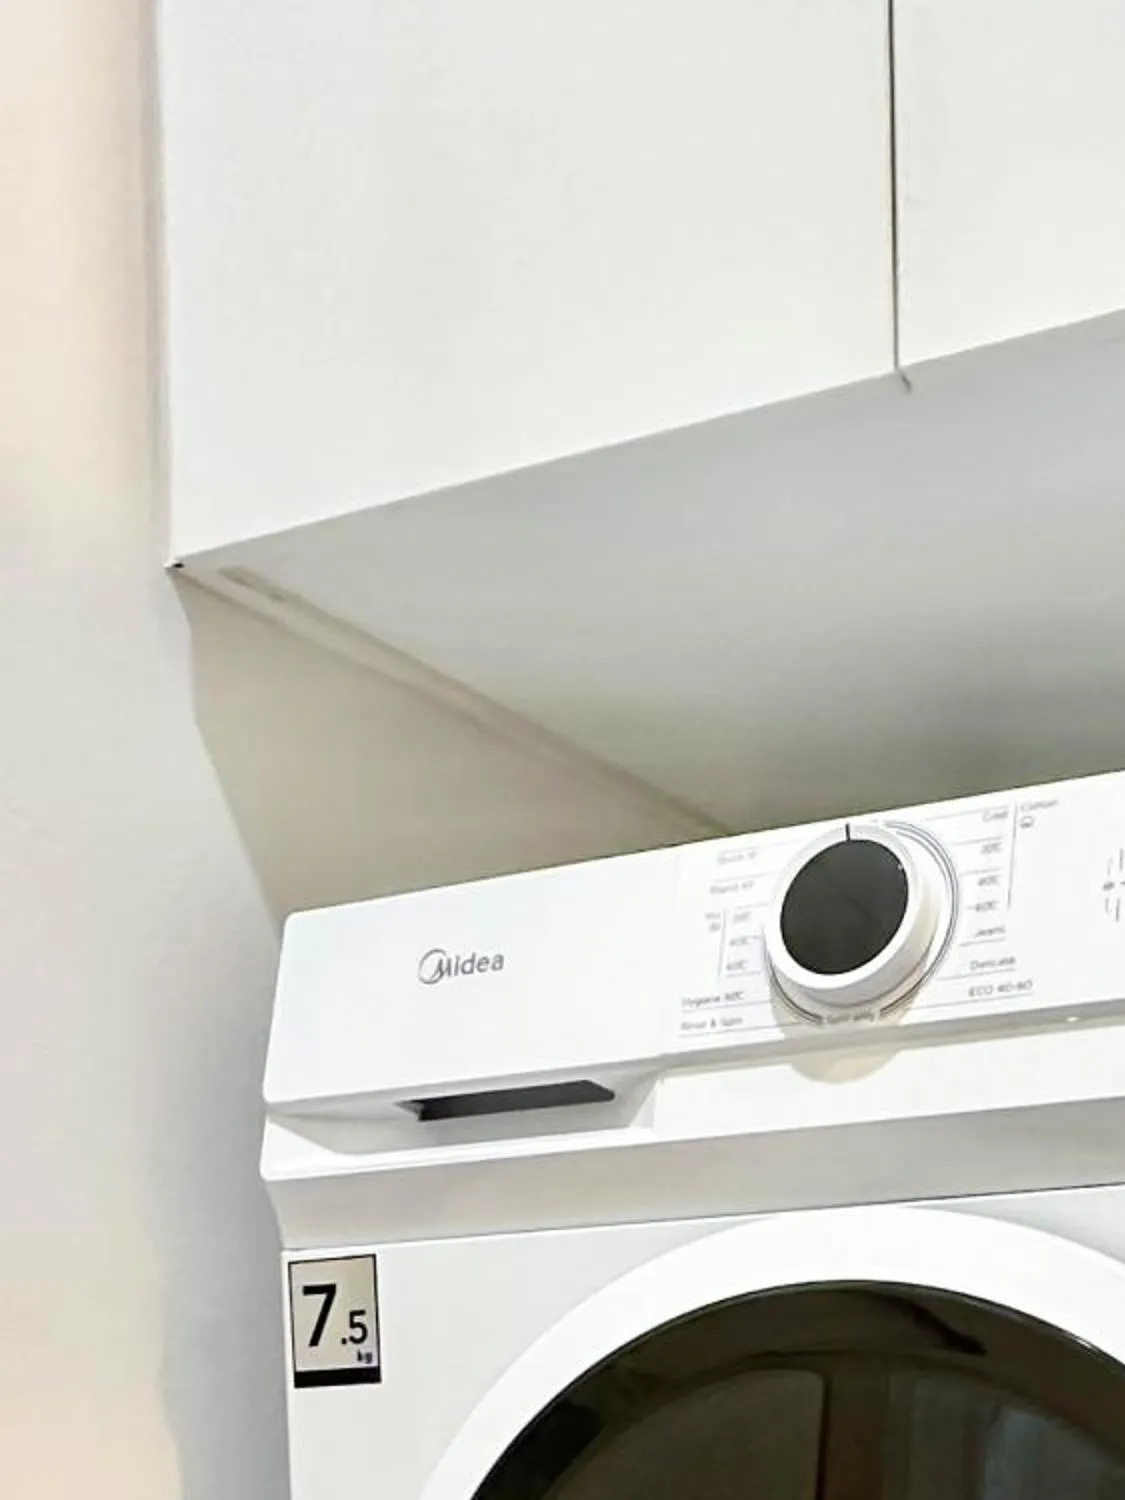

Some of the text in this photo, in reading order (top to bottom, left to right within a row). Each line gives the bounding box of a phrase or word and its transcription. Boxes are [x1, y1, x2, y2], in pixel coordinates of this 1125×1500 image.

[419, 948, 504, 985] Midea
[968, 985, 993, 997] ECO
[357, 1351, 373, 1364] kg
